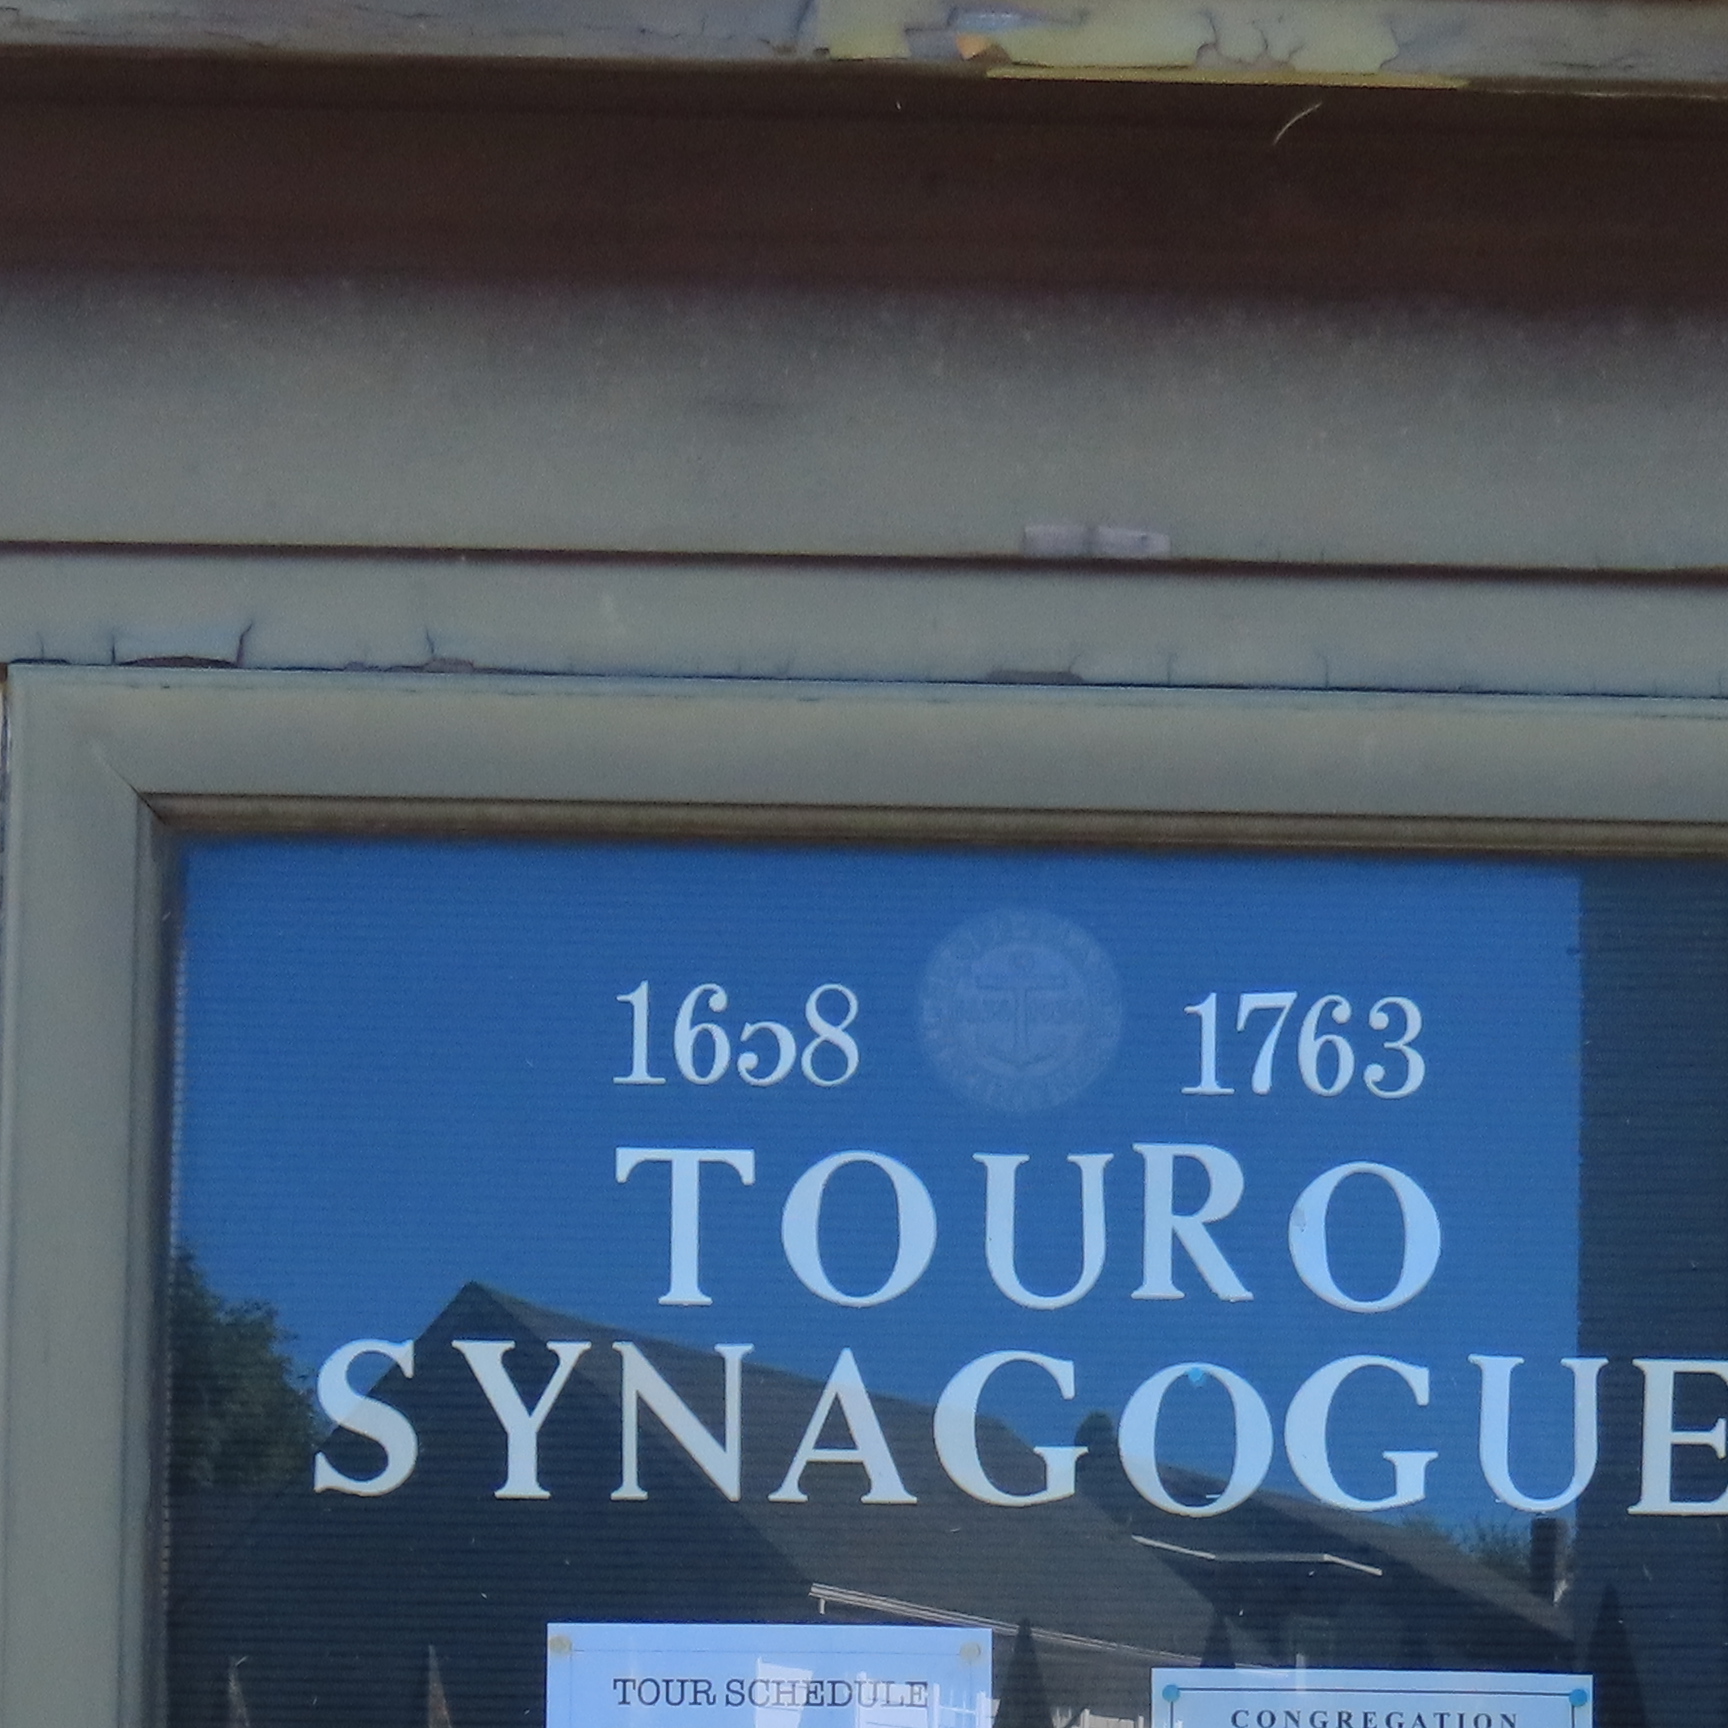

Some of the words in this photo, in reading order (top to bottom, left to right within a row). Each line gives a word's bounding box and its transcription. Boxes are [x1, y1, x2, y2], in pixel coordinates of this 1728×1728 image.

[1183, 991, 1426, 1098] 1763
[616, 1144, 1443, 1314] TOURO
[614, 1678, 717, 1707] TOUR
[726, 1679, 929, 1708] SCHEDULE
